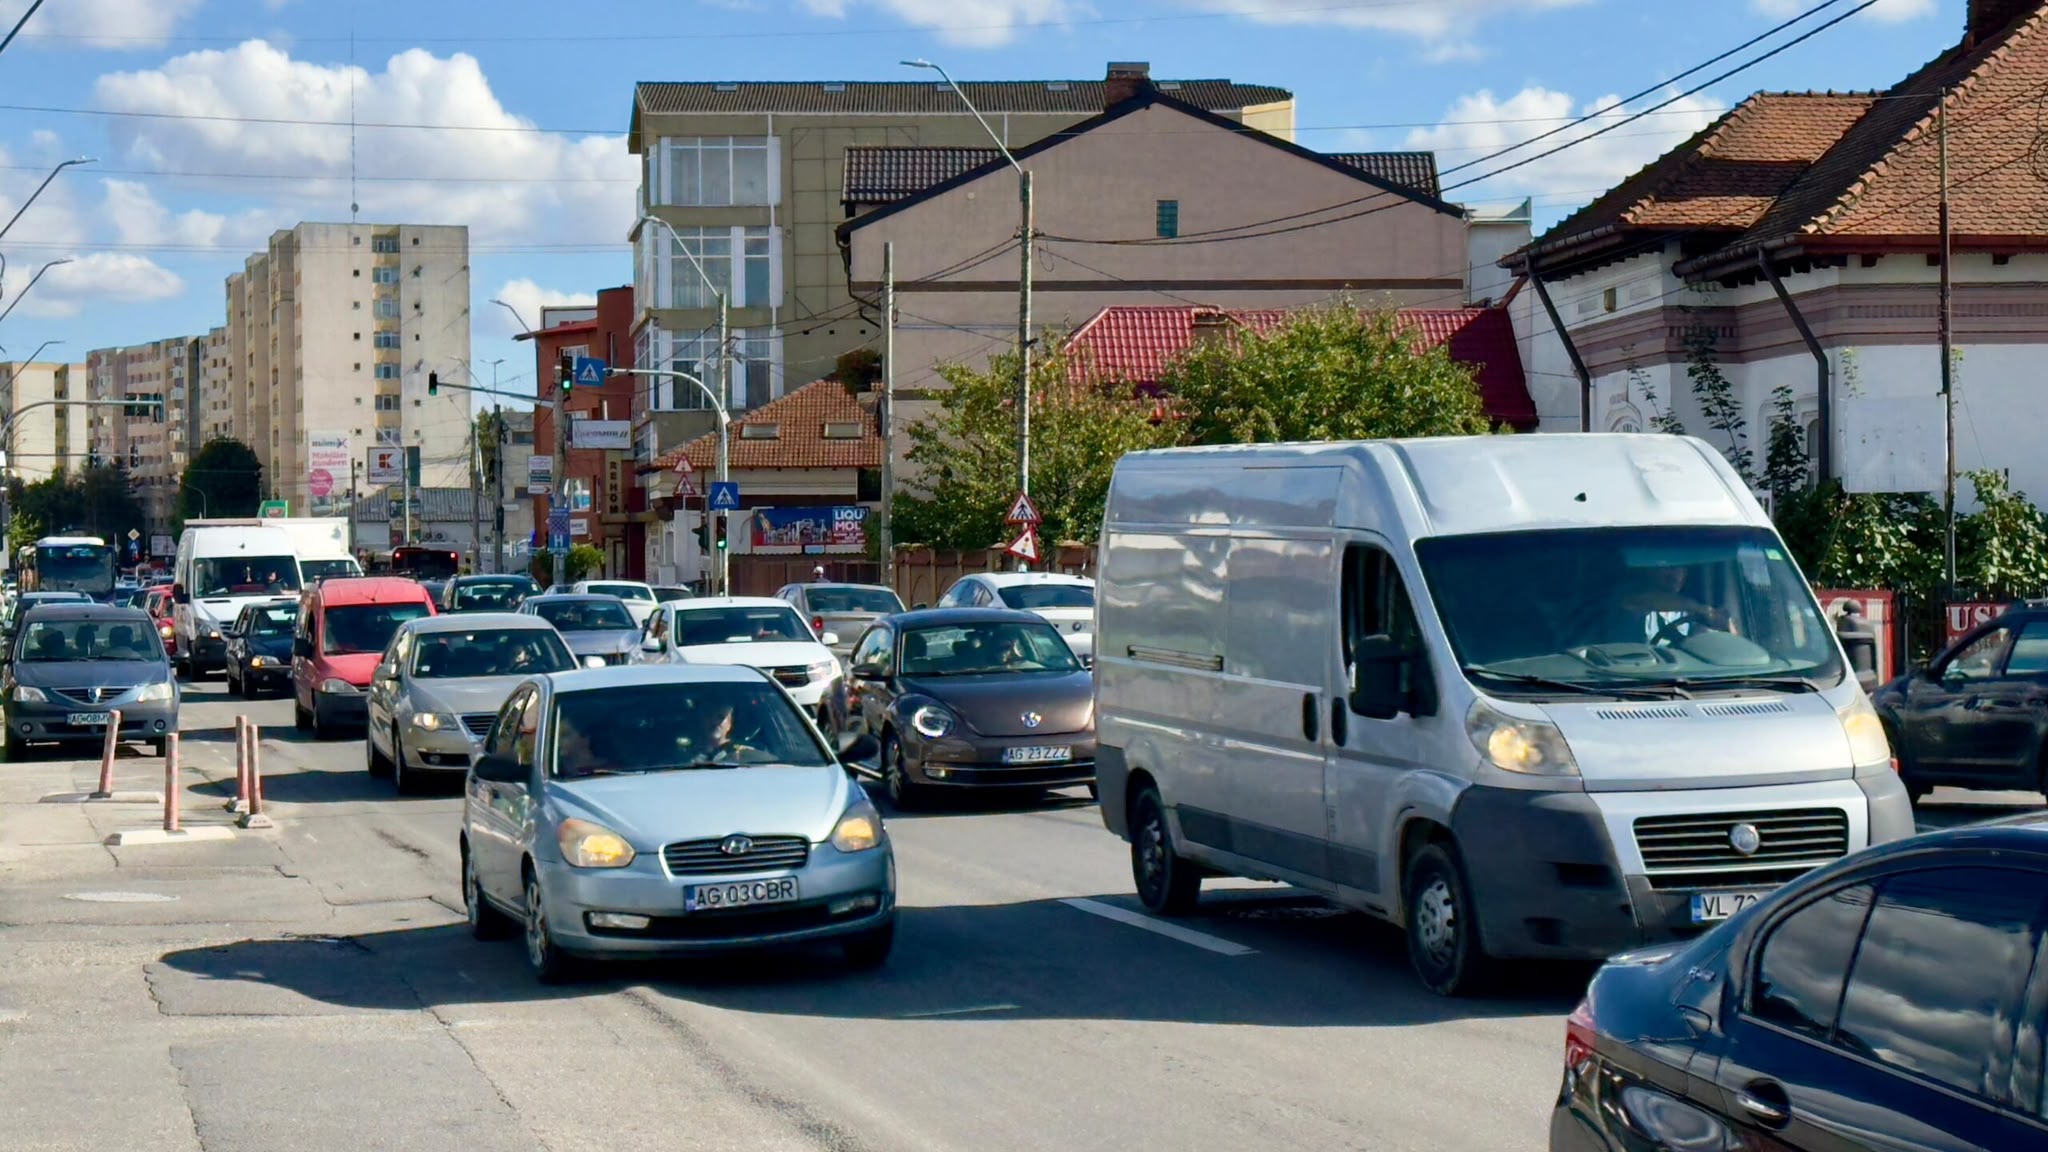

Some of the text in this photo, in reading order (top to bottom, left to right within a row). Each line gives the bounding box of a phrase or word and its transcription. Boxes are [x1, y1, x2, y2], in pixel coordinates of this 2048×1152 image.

[835, 520, 863, 531] MOL
[1008, 746, 1069, 760] AG 23 ZZZ
[697, 880, 793, 905] AG 03 CBR
[1702, 895, 1728, 916] VL
